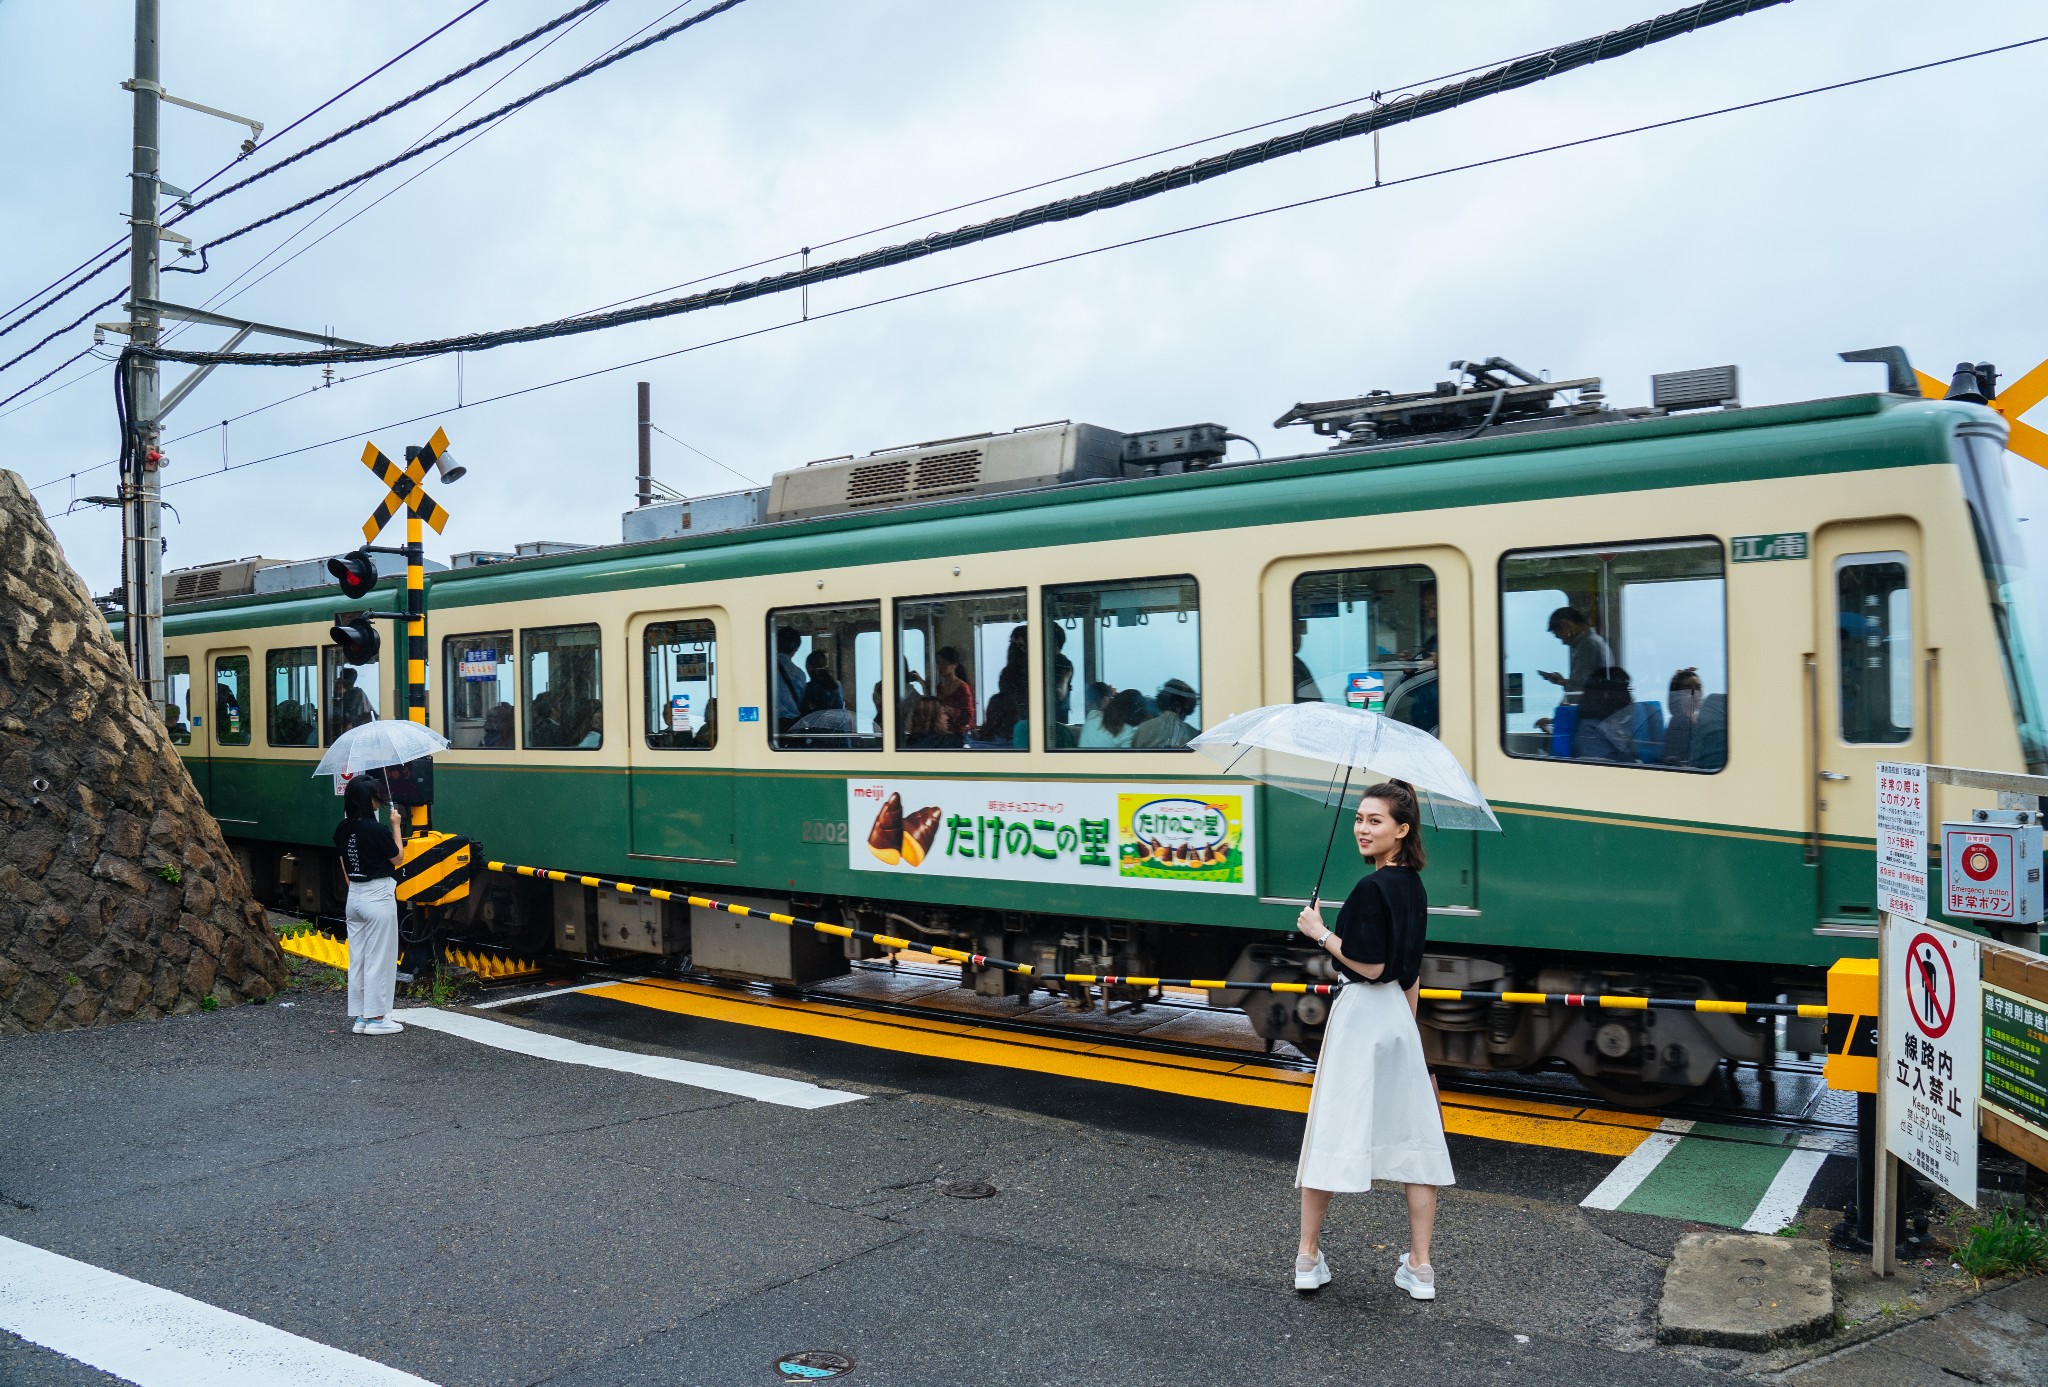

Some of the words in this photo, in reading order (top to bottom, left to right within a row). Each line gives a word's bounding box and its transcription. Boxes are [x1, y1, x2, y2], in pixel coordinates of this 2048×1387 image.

[1732, 534, 1805, 560] 江ノ電
[854, 785, 884, 801] meiji
[1880, 777, 1920, 793] 非常の際は
[988, 800, 1064, 813] 明治チョコスナック
[1880, 793, 1921, 809] このボタンを
[802, 821, 848, 843] 2002
[1139, 814, 1219, 836] たけのこの里
[946, 814, 1111, 867] たけのこの里
[1951, 884, 1986, 895] Emergency
[1988, 887, 2009, 896] button
[1951, 893, 2011, 913] 非常ボタン
[1904, 1031, 1953, 1081] 線路内
[1896, 1058, 1962, 1117] 立入禁止
[1912, 1095, 1930, 1117] Keep
[1931, 1107, 1946, 1125] Out
[1900, 1118, 1913, 1136] 선로
[1916, 1128, 1924, 1144] 내
[1928, 1135, 1942, 1155] 진입
[1944, 1145, 1960, 1167] 금지
